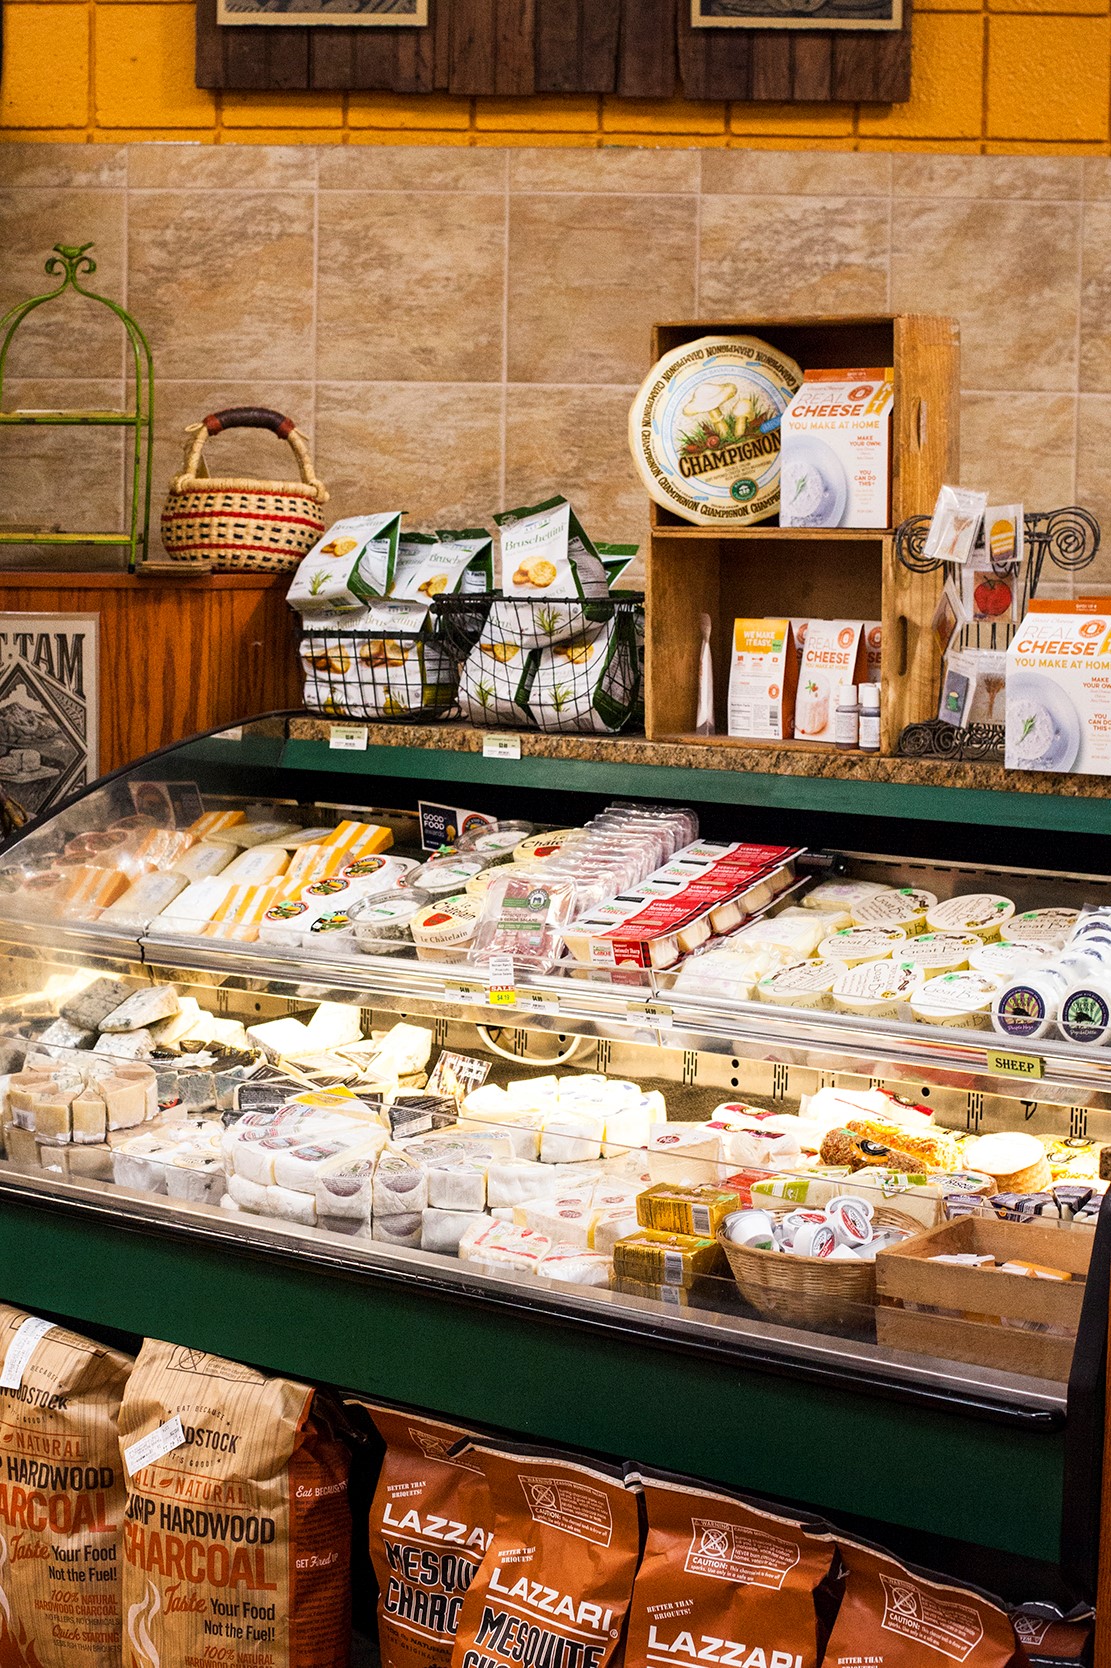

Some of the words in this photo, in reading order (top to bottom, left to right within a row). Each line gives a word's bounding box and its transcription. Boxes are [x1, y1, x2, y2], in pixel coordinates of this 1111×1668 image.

[706, 344, 755, 358] CHAMPIGNON
[661, 349, 705, 385] CHAMPIGNON
[641, 381, 666, 429] CHAMPIGNON
[798, 393, 844, 404] REAL
[791, 404, 865, 418] CHEESE
[789, 422, 808, 430] YOU
[810, 422, 836, 430] MAKE
[839, 421, 849, 430] AT
[852, 420, 880, 430] HOME
[641, 430, 662, 481] CHAMPIGNON
[678, 431, 781, 478] CHAMPIGNON
[658, 476, 700, 512] CHAMPIGNON
[700, 504, 749, 518] CHAMPIGNON
[505, 525, 566, 552] Bruschettini
[744, 631, 753, 639] WE
[754, 631, 776, 640] MAKE
[1023, 625, 1075, 641] REAL
[809, 637, 836, 650] REAL
[1017, 640, 1098, 656] CHEESE
[806, 651, 851, 664] CHEESE
[1015, 658, 1036, 667] YOU
[1039, 659, 1068, 669] MAKE
[1070, 660, 1083, 669] AT
[423, 813, 445, 823] GOOD
[424, 820, 445, 830] FOOD
[429, 930, 468, 943] Châtelain
[995, 1058, 1035, 1073] SHEEP
[30, 1364, 58, 1382] BECAUSE
[176, 1405, 191, 1413] EAT
[195, 1405, 226, 1422] BECAUSE
[16, 1432, 85, 1458] NATURAL
[7, 1456, 114, 1492] HARDWOOD
[135, 1468, 157, 1490] ALL
[175, 1479, 247, 1505] NATURAL
[296, 1485, 313, 1498] Eat
[315, 1483, 341, 1497] BECAUSE
[387, 1483, 409, 1493] BETTER
[412, 1481, 427, 1489] THAN
[535, 1508, 562, 1520] CAUTION:
[160, 1503, 275, 1544] HARDWOOD
[702, 1520, 730, 1530] WARNING
[10, 1535, 51, 1564] Taste
[51, 1545, 82, 1562] Your
[84, 1544, 117, 1562] Food
[123, 1522, 277, 1591] CHARCOAL
[296, 1558, 309, 1569] GET
[310, 1553, 332, 1568] Fired
[692, 1557, 728, 1570] CAUTION:
[48, 1566, 66, 1581] Not
[68, 1569, 86, 1582] the
[89, 1567, 117, 1582] Fuel!
[51, 1590, 80, 1603] 100%
[81, 1595, 118, 1605] NATURAL
[164, 1582, 208, 1616] Taste
[210, 1598, 240, 1617] Your
[243, 1602, 276, 1621] Food
[488, 1567, 613, 1633] LAZZARI
[34, 1600, 75, 1615] HARDWOOD
[76, 1605, 118, 1616] CHARCOAL
[646, 1602, 674, 1613] BETTER
[675, 1600, 694, 1610] THAN
[654, 1608, 692, 1620] BRIQUETS!
[889, 1612, 921, 1630] CAUTION:
[52, 1624, 81, 1640] Quick
[82, 1631, 120, 1643] STARTING
[204, 1620, 224, 1637] Not
[225, 1623, 243, 1640] the
[246, 1627, 276, 1642] Fuel!
[474, 1605, 606, 1668] MESQUITE
[647, 1625, 803, 1668] LAZZARI
[204, 1646, 235, 1661] 100%
[237, 1653, 275, 1665] NATURAL
[864, 1655, 884, 1663] THAN
